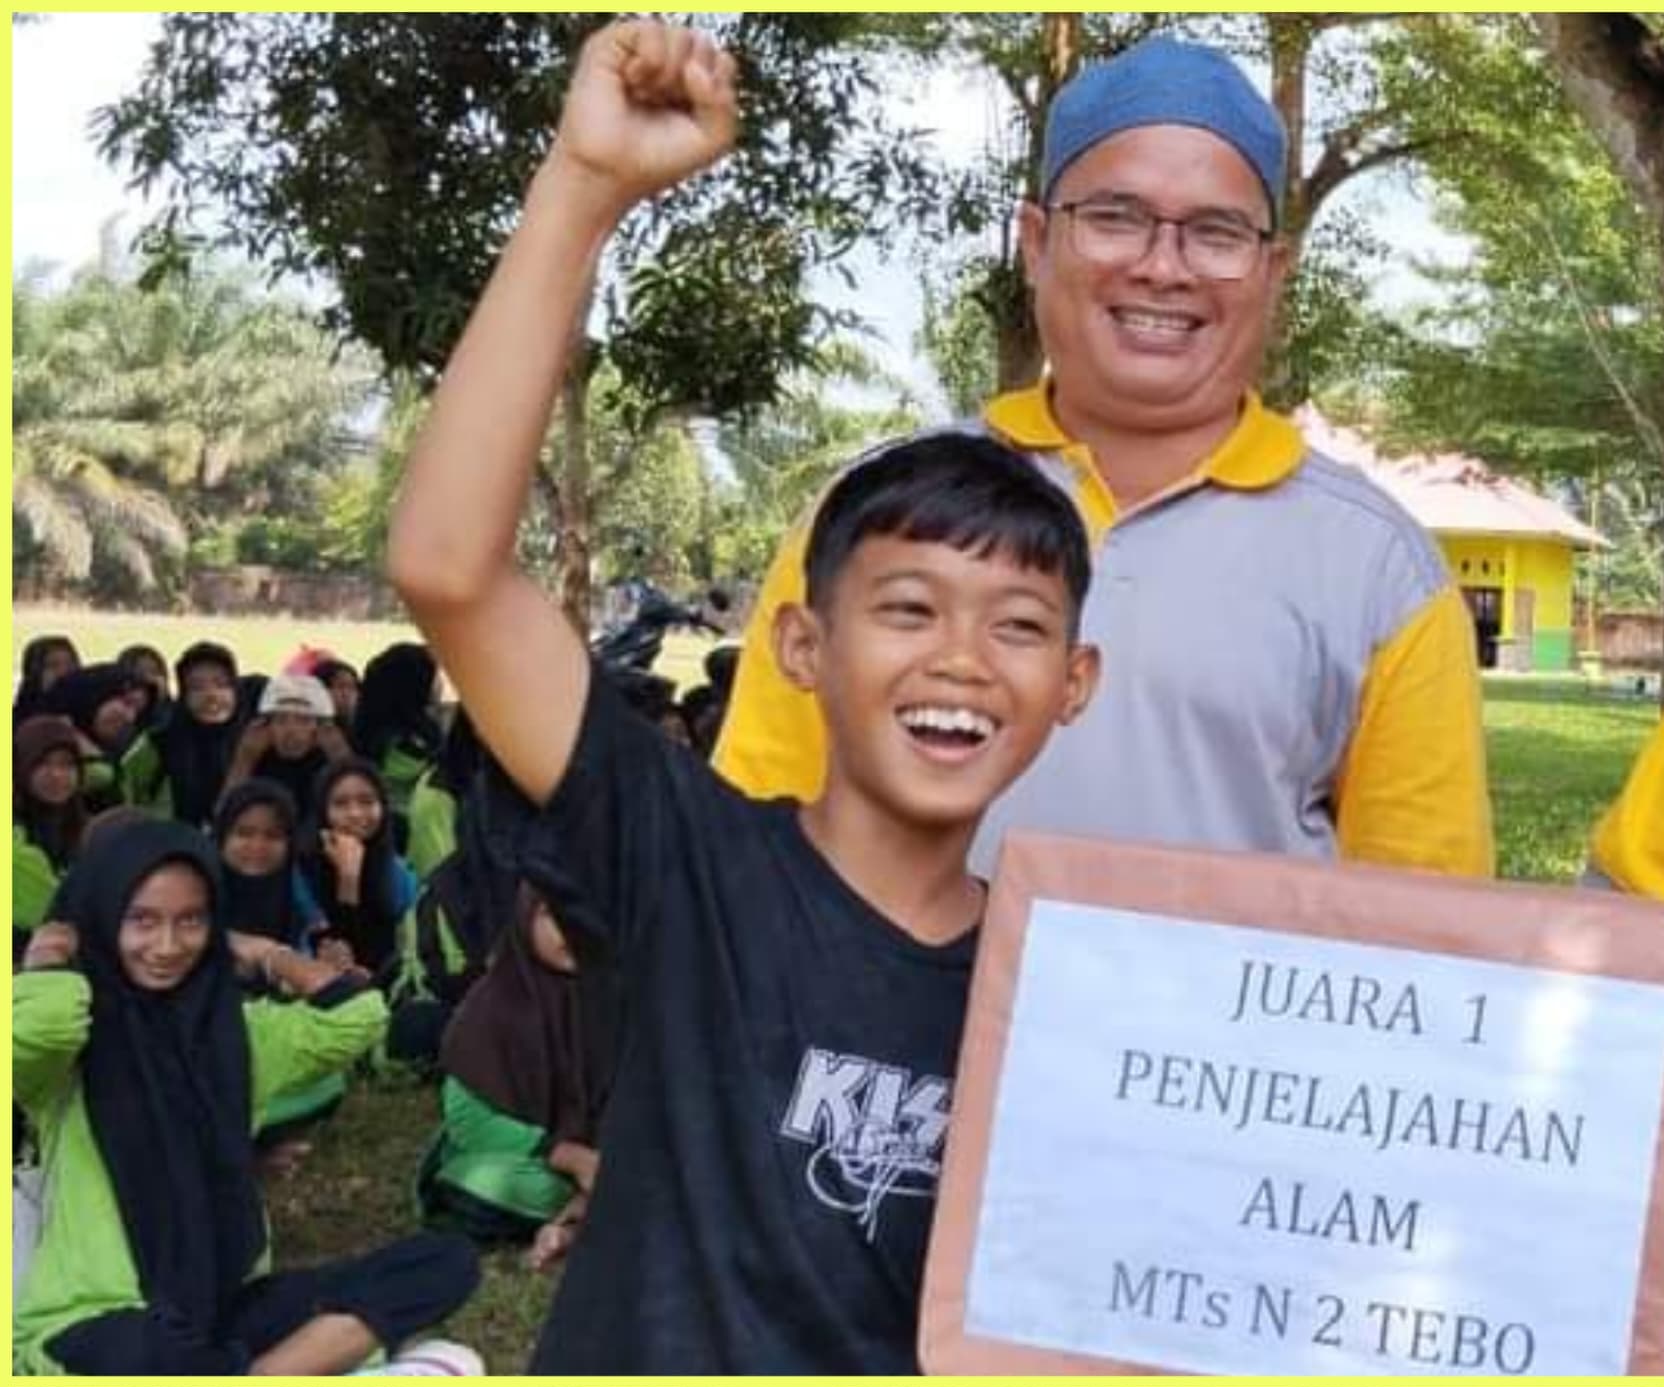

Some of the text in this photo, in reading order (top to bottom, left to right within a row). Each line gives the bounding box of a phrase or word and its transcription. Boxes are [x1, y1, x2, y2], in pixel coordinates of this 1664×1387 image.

[1229, 959, 1489, 1047] JUARA 1
[1114, 1047, 1587, 1168] PENJELAJAHAN
[1238, 1175, 1424, 1253] ALAM
[1107, 1260, 1538, 1376] MTs N 2 TEBO
